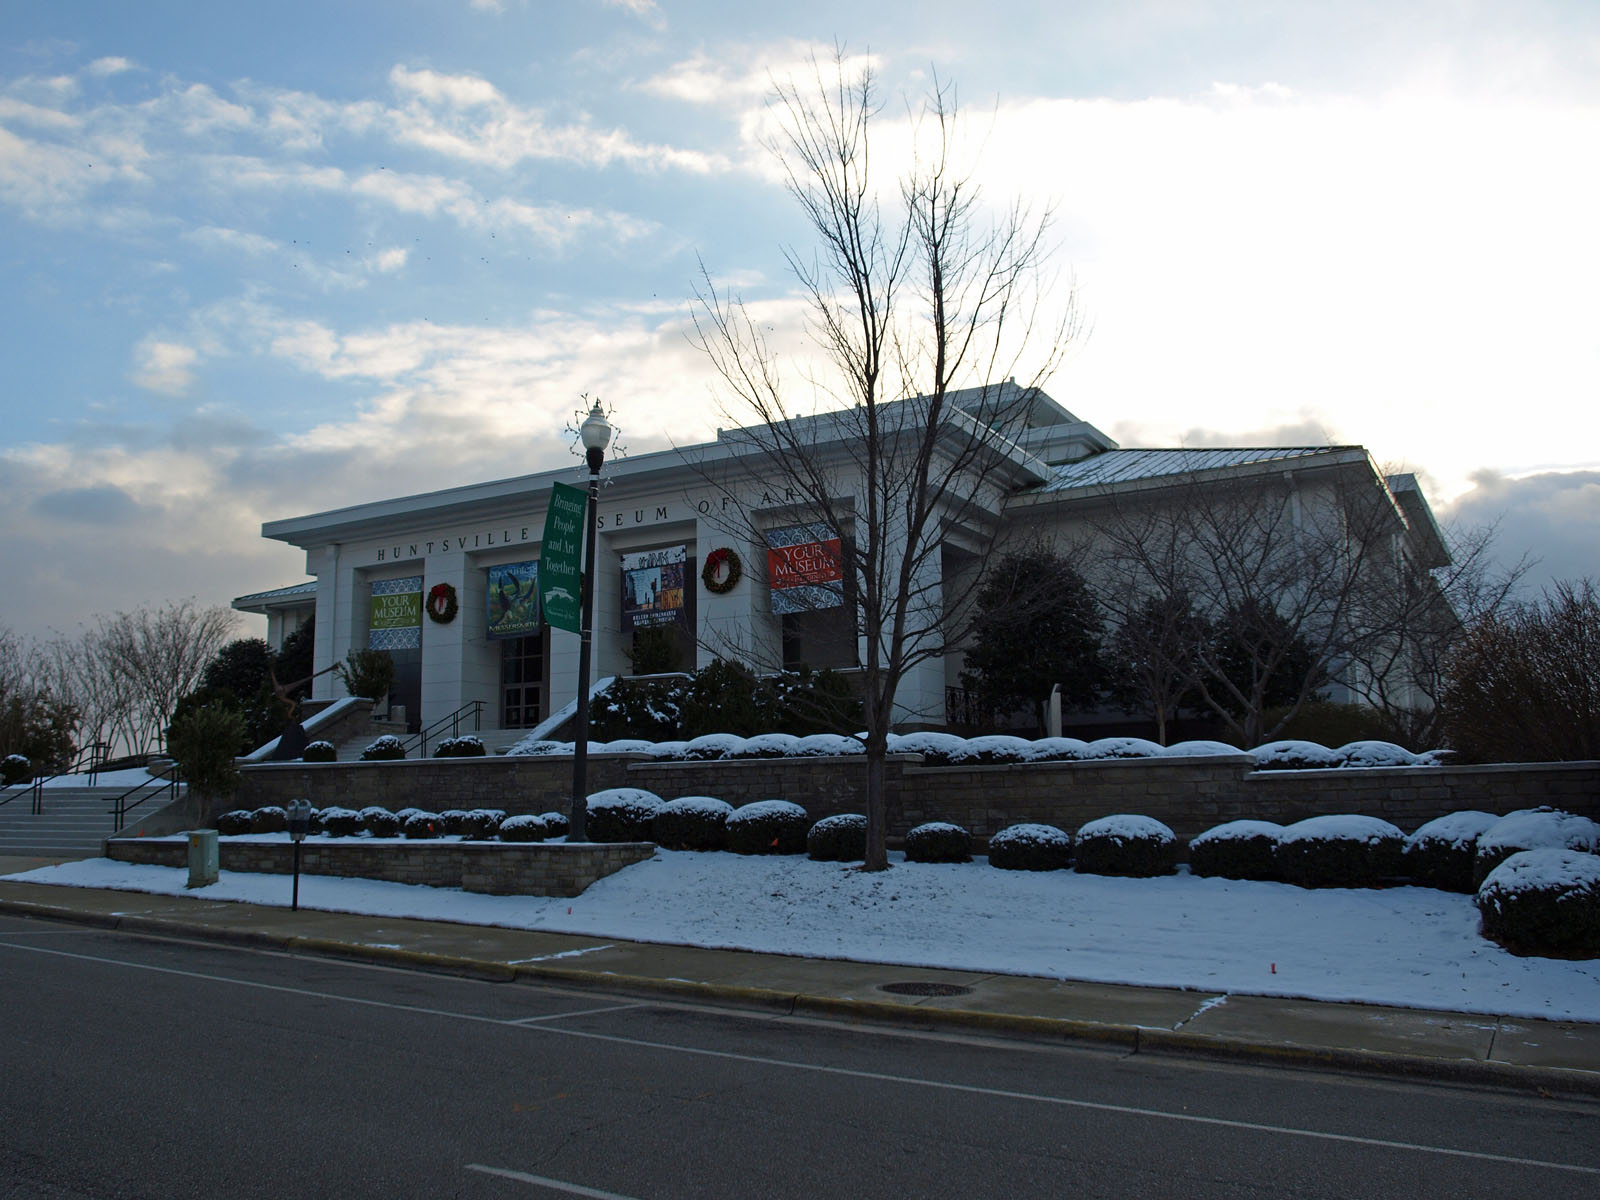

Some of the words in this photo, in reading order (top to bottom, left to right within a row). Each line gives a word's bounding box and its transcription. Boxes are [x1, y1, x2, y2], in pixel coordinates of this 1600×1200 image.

[554, 494, 583, 518] Bringing
[377, 528, 529, 561] HUNTSVILLE
[596, 506, 668, 529] SEUM
[698, 496, 731, 514] OF
[554, 515, 576, 536] People
[548, 540, 562, 552] and
[563, 540, 575, 555] Art
[783, 544, 824, 561] YOUR
[545, 557, 576, 576] Together
[776, 556, 835, 576] MUSEUM
[381, 595, 410, 608] YOUR
[374, 605, 417, 618] MUSEUM
